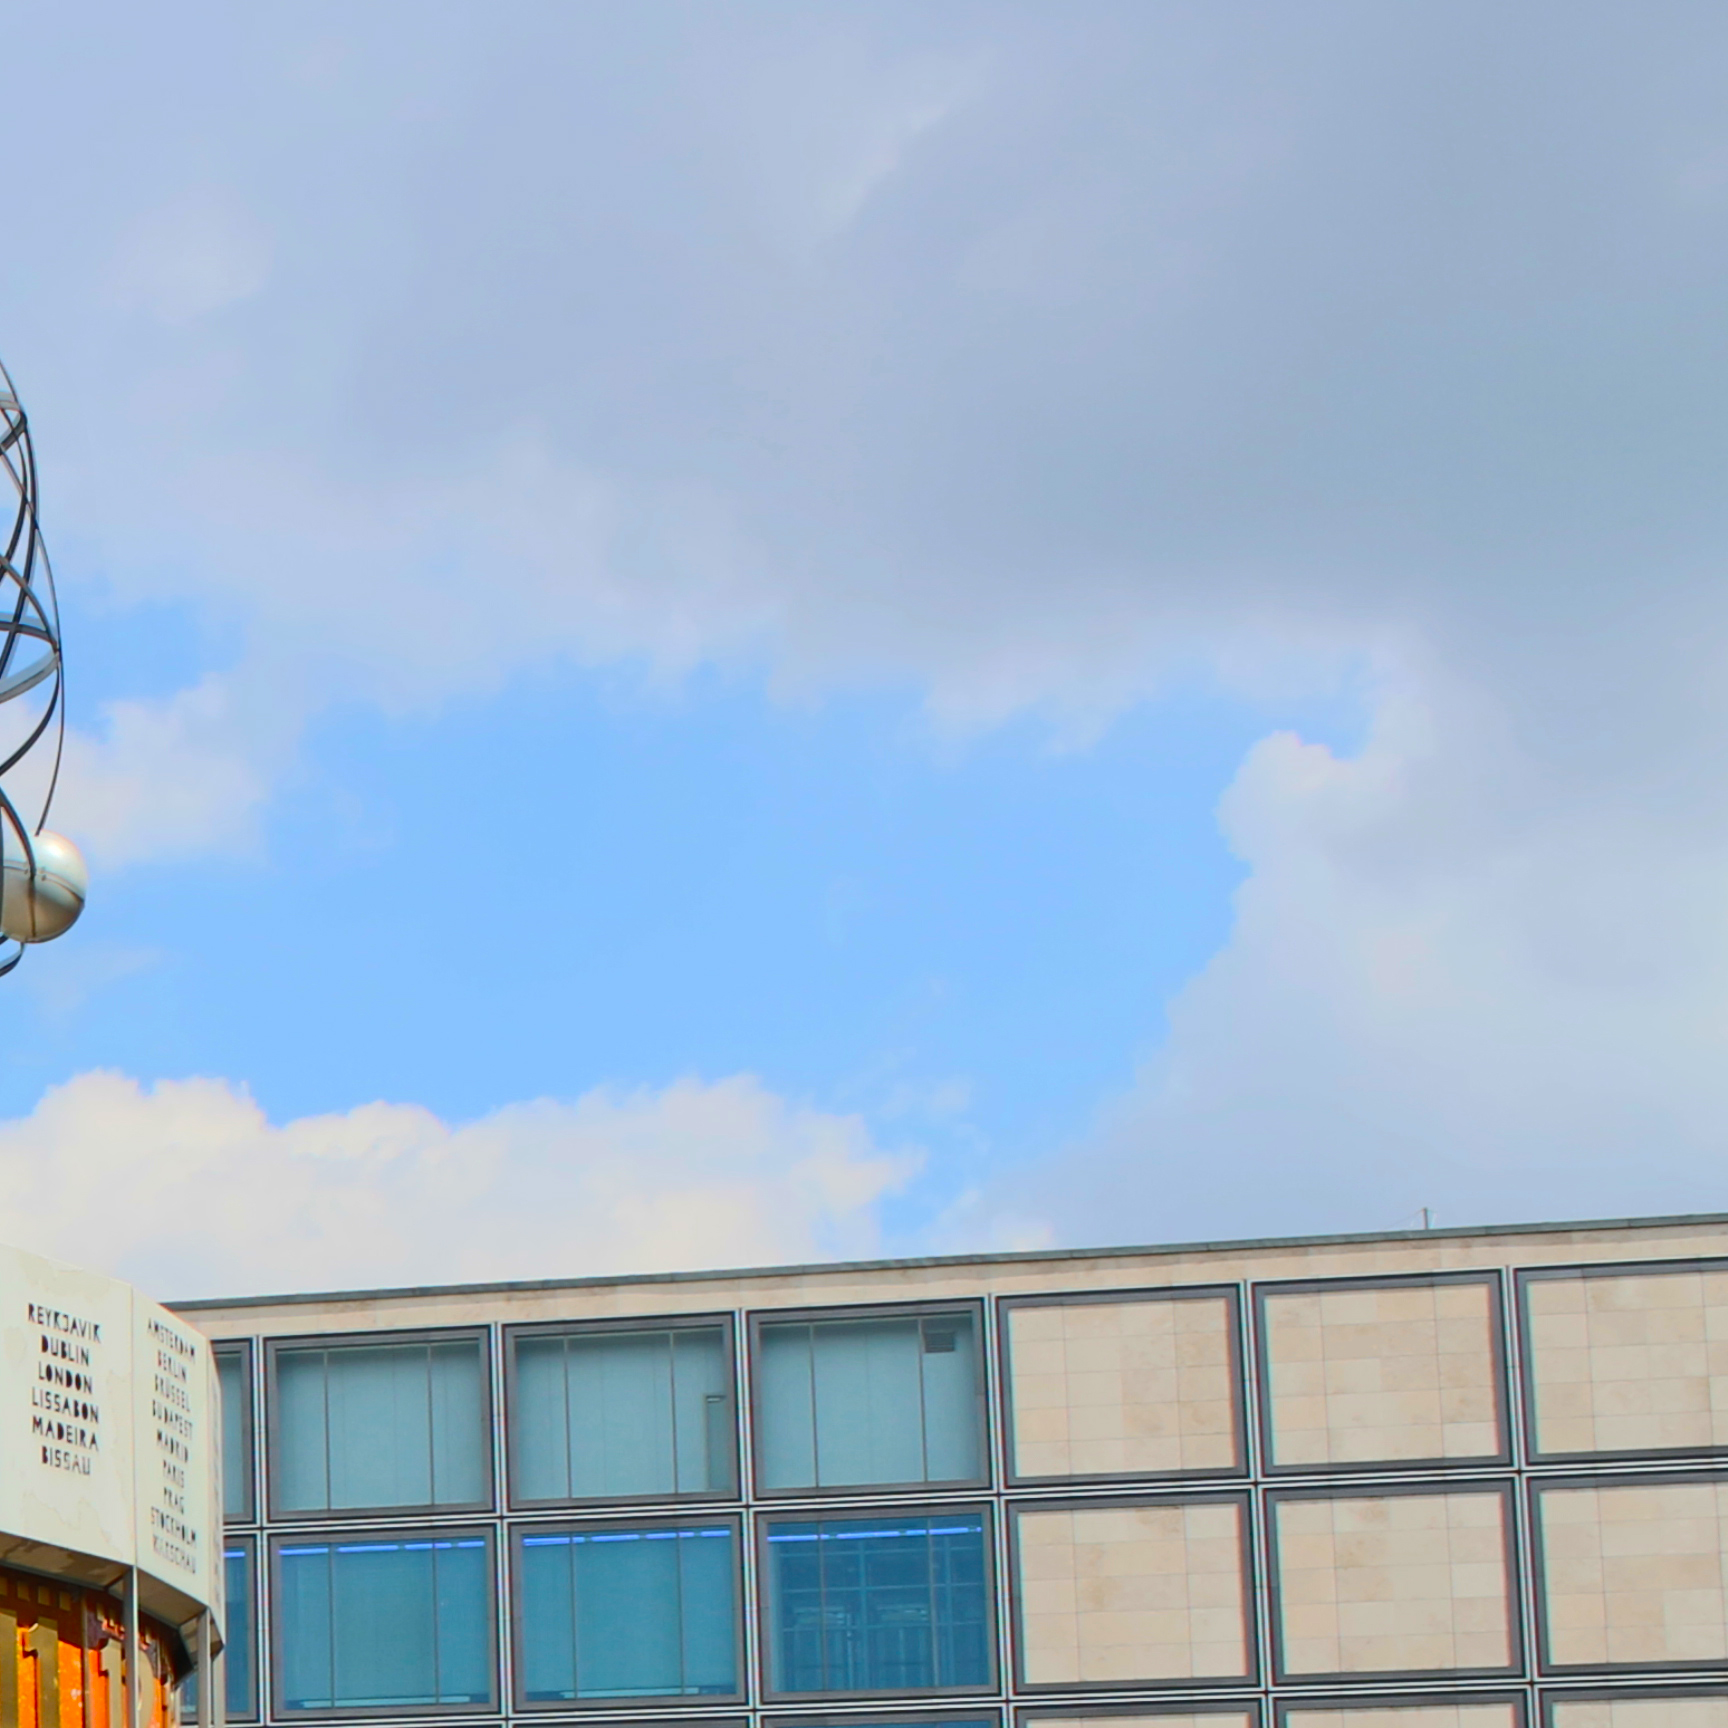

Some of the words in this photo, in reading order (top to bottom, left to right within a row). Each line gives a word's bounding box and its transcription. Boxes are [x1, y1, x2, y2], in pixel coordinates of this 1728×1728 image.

[28, 1303, 100, 1343] REYKJAVIK
[41, 1334, 90, 1367] DUBLIN
[147, 1318, 195, 1364] AMSTERDAM
[38, 1361, 92, 1395] LONDON
[157, 1350, 187, 1384] BERLIN
[32, 1387, 99, 1424] LISSABON
[152, 1399, 192, 1439] BUDAPEST
[32, 1415, 99, 1451] MADEIRA
[156, 1428, 189, 1462] MADRID
[41, 1446, 91, 1475] BISSAU
[162, 1460, 184, 1488] PARIS
[163, 1487, 184, 1514] PRAG
[151, 1506, 196, 1548] STOCKHOLM
